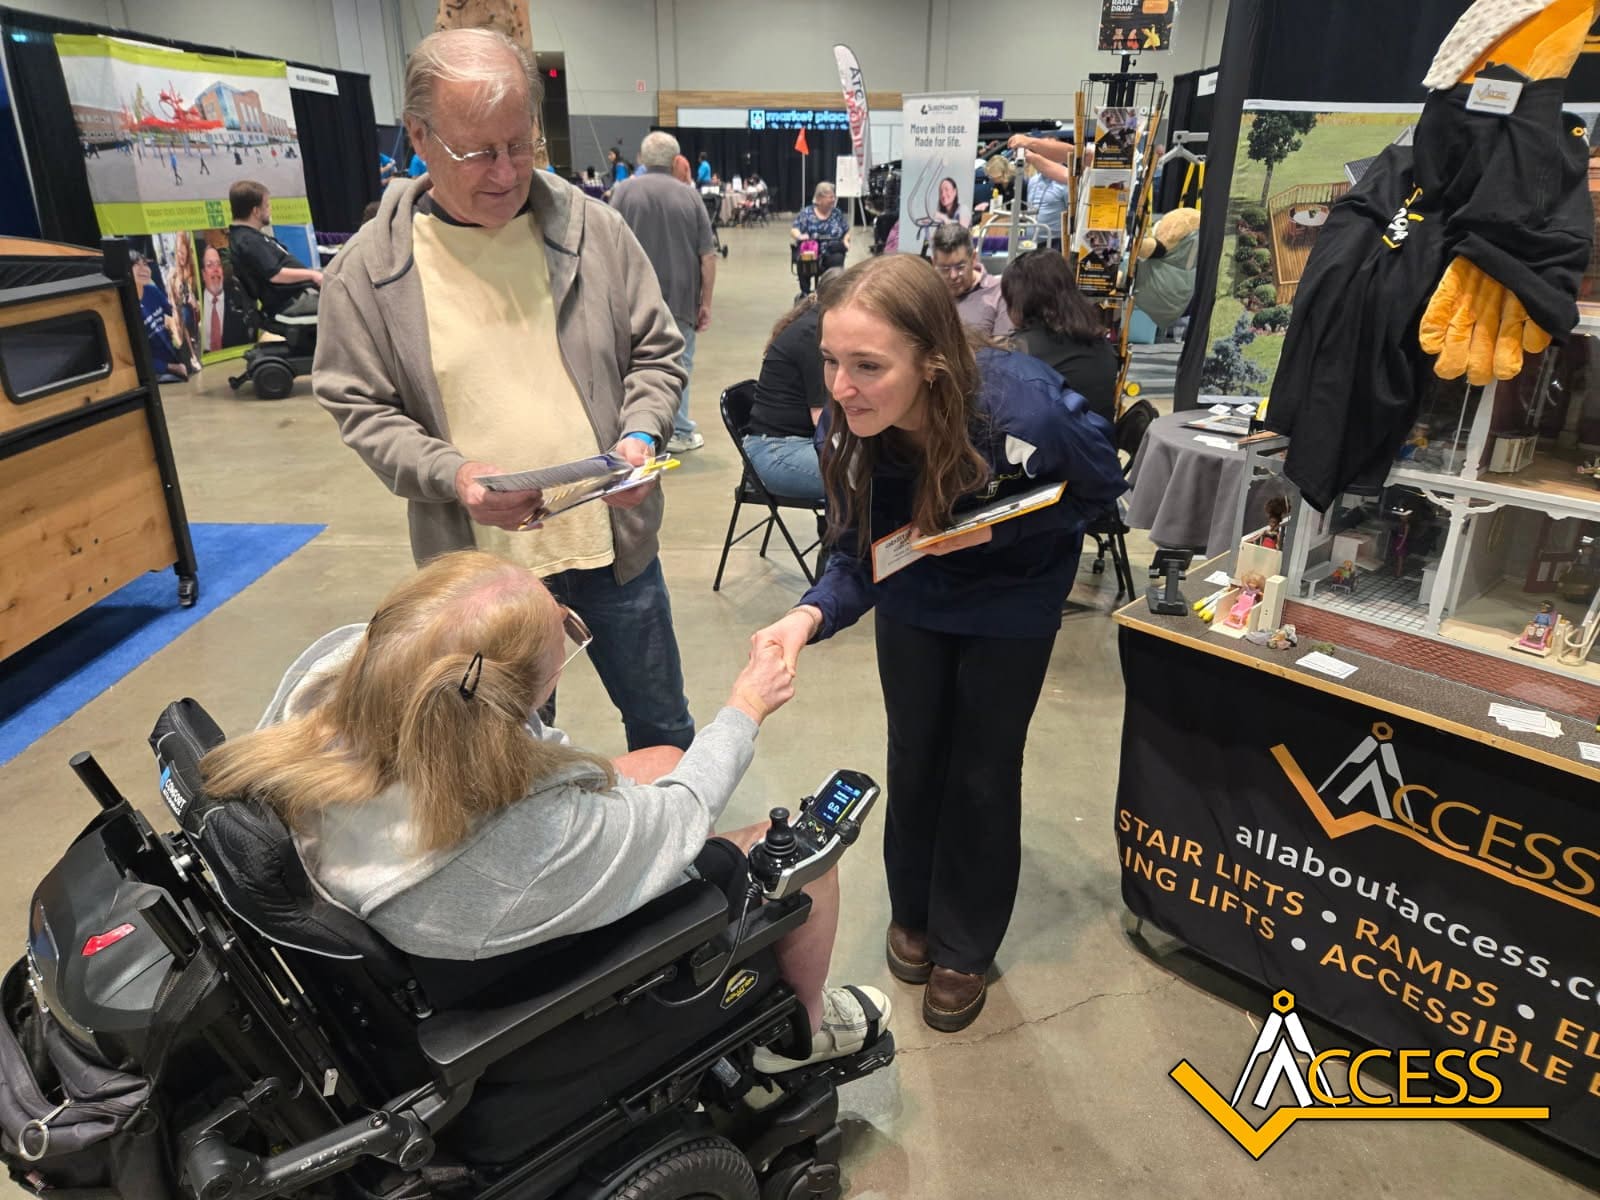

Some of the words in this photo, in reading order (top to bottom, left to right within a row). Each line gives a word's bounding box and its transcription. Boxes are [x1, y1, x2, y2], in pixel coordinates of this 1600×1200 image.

[766, 110, 813, 122] market
[979, 105, 998, 117] ffice
[910, 123, 929, 135] Move
[930, 123, 945, 135] with
[947, 125, 968, 134] ease.
[914, 136, 934, 147] Made
[934, 136, 946, 147] for
[947, 136, 962, 147] life.
[1119, 808, 1203, 868] STAIR
[1215, 852, 1305, 917] LIFTS
[1355, 917, 1499, 1008] RAMPS
[1235, 825, 1600, 1006] allaboutaccess.c
[1121, 846, 1178, 893] ING
[1189, 877, 1276, 941] LIFTS
[1319, 943, 1574, 1086] ACCESSIBLE
